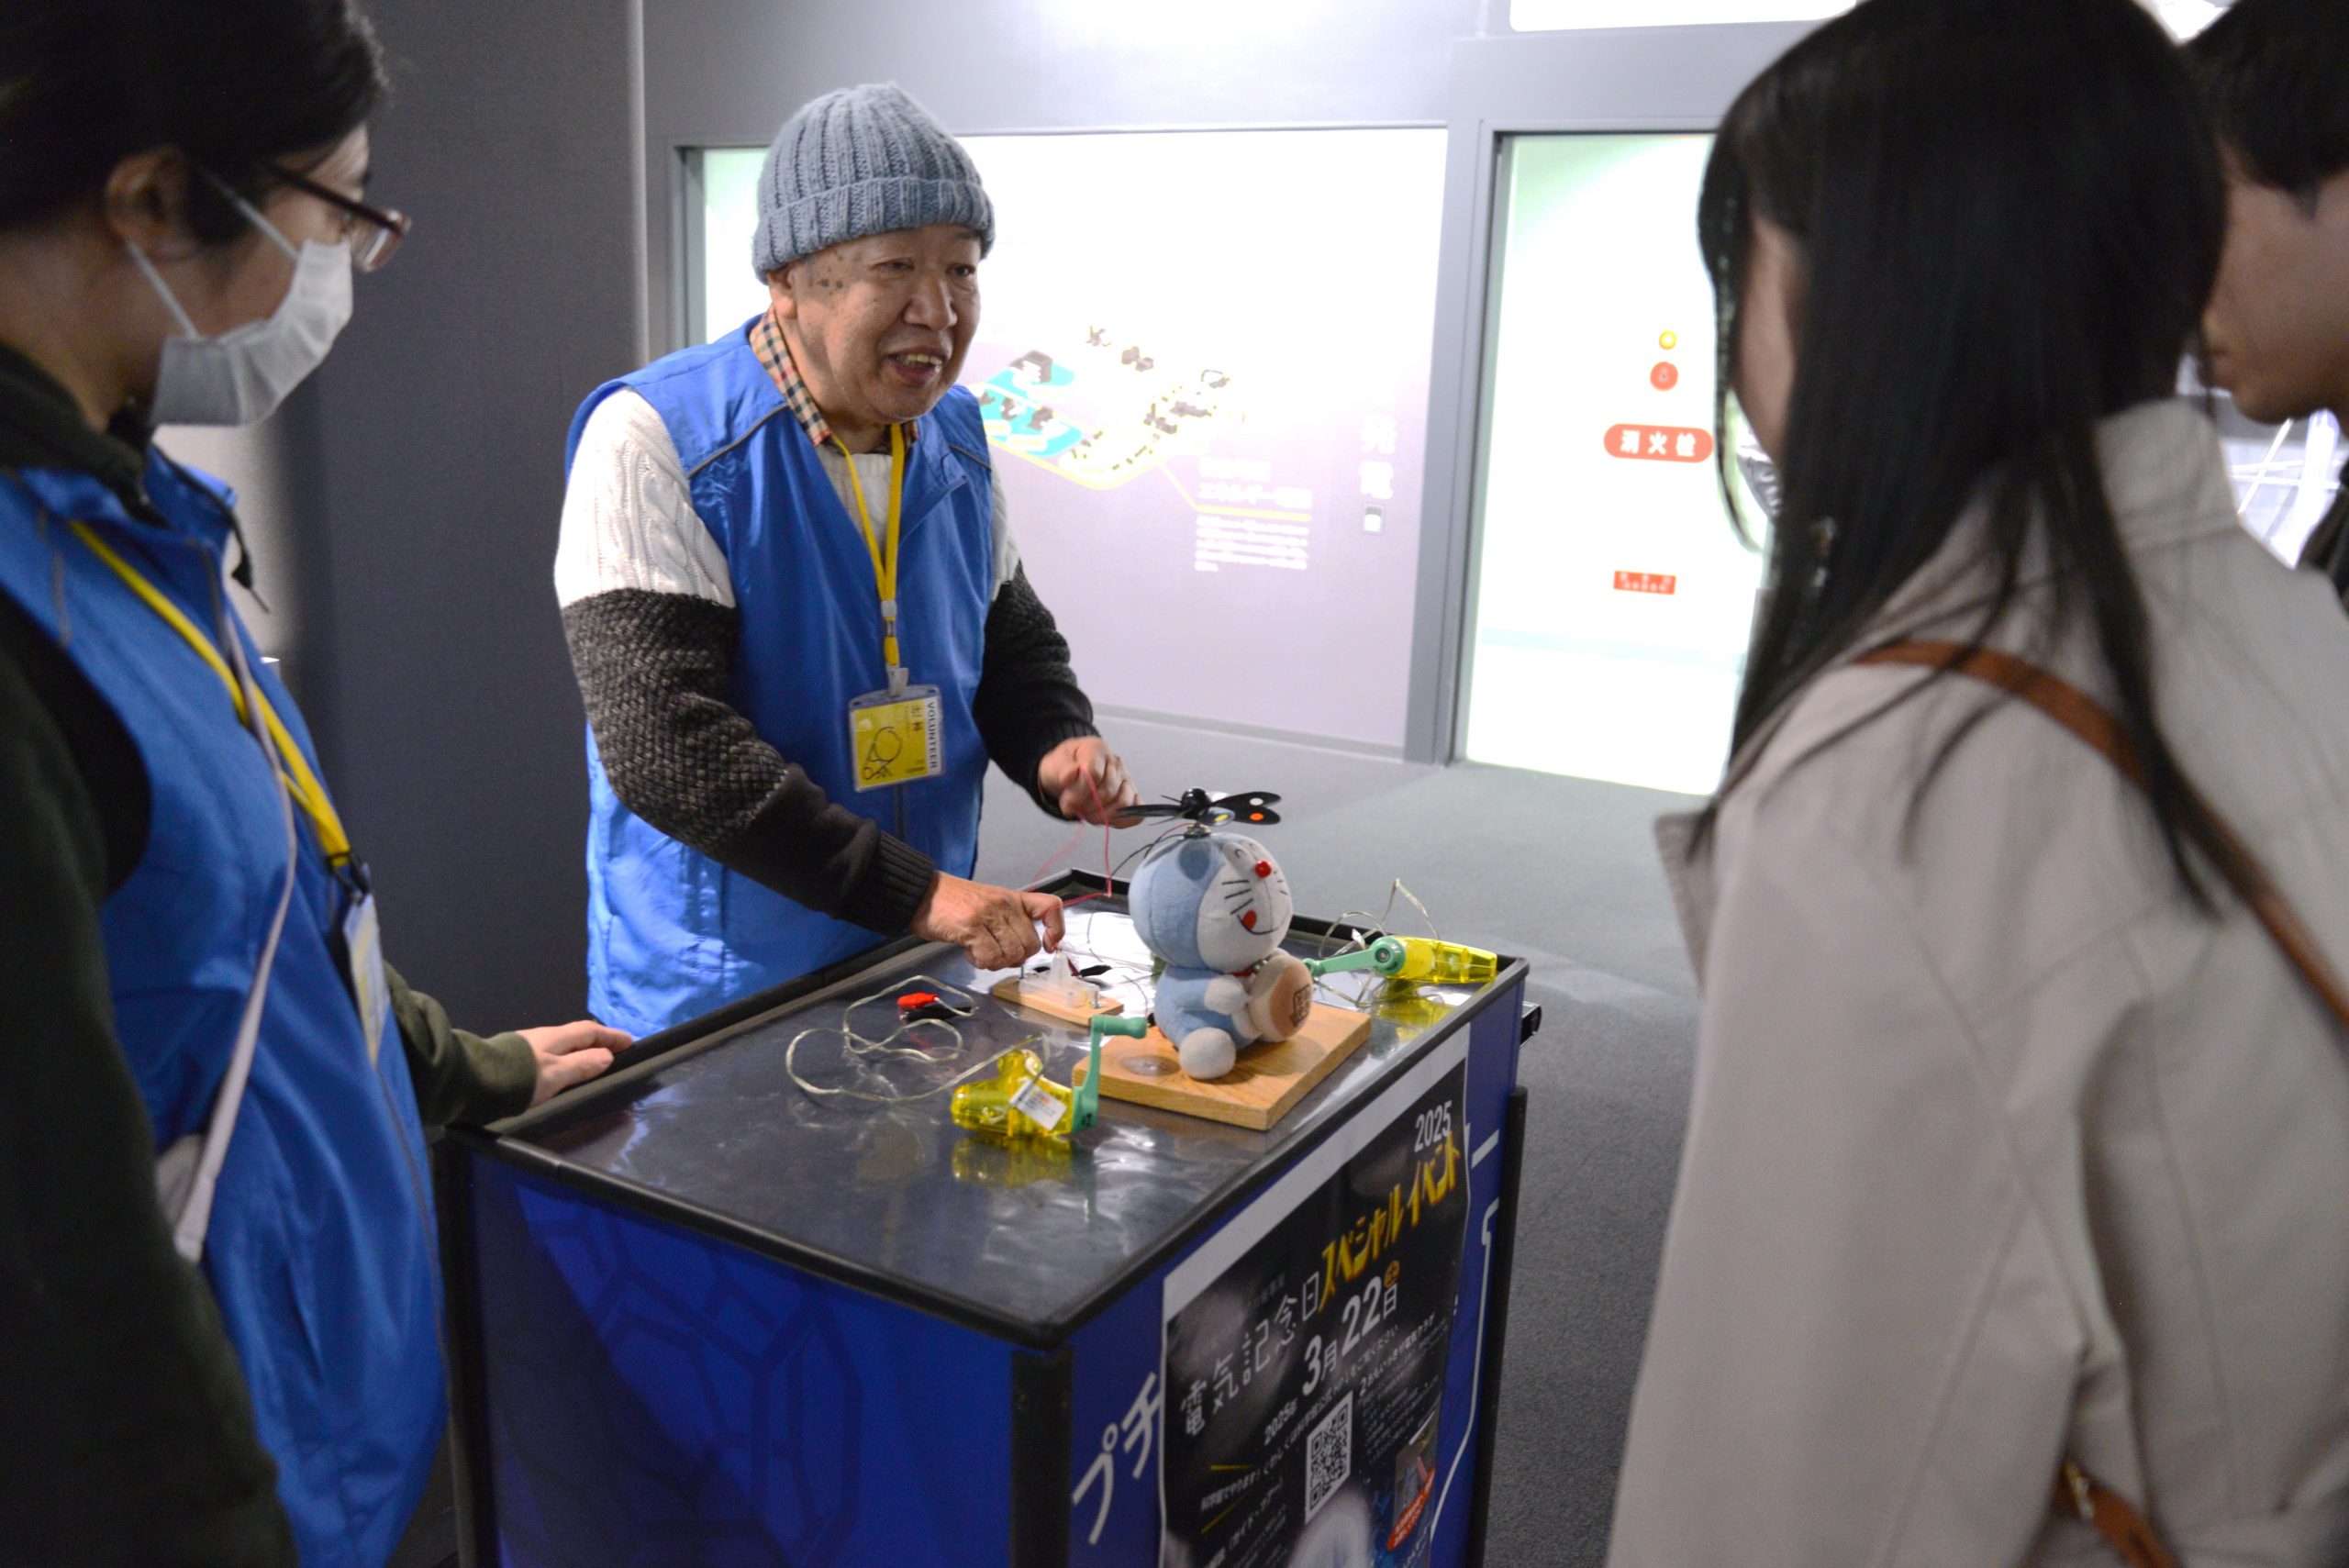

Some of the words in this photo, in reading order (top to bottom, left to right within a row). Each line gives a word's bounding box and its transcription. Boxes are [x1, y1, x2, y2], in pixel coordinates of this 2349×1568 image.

[1620, 430, 1696, 457] 消火栓
[926, 701, 938, 769] VOLUNTEER
[1414, 1099, 1453, 1152] 2025
[1179, 1271, 1319, 1437] 電気記念日
[1072, 1373, 1163, 1546] プチ
